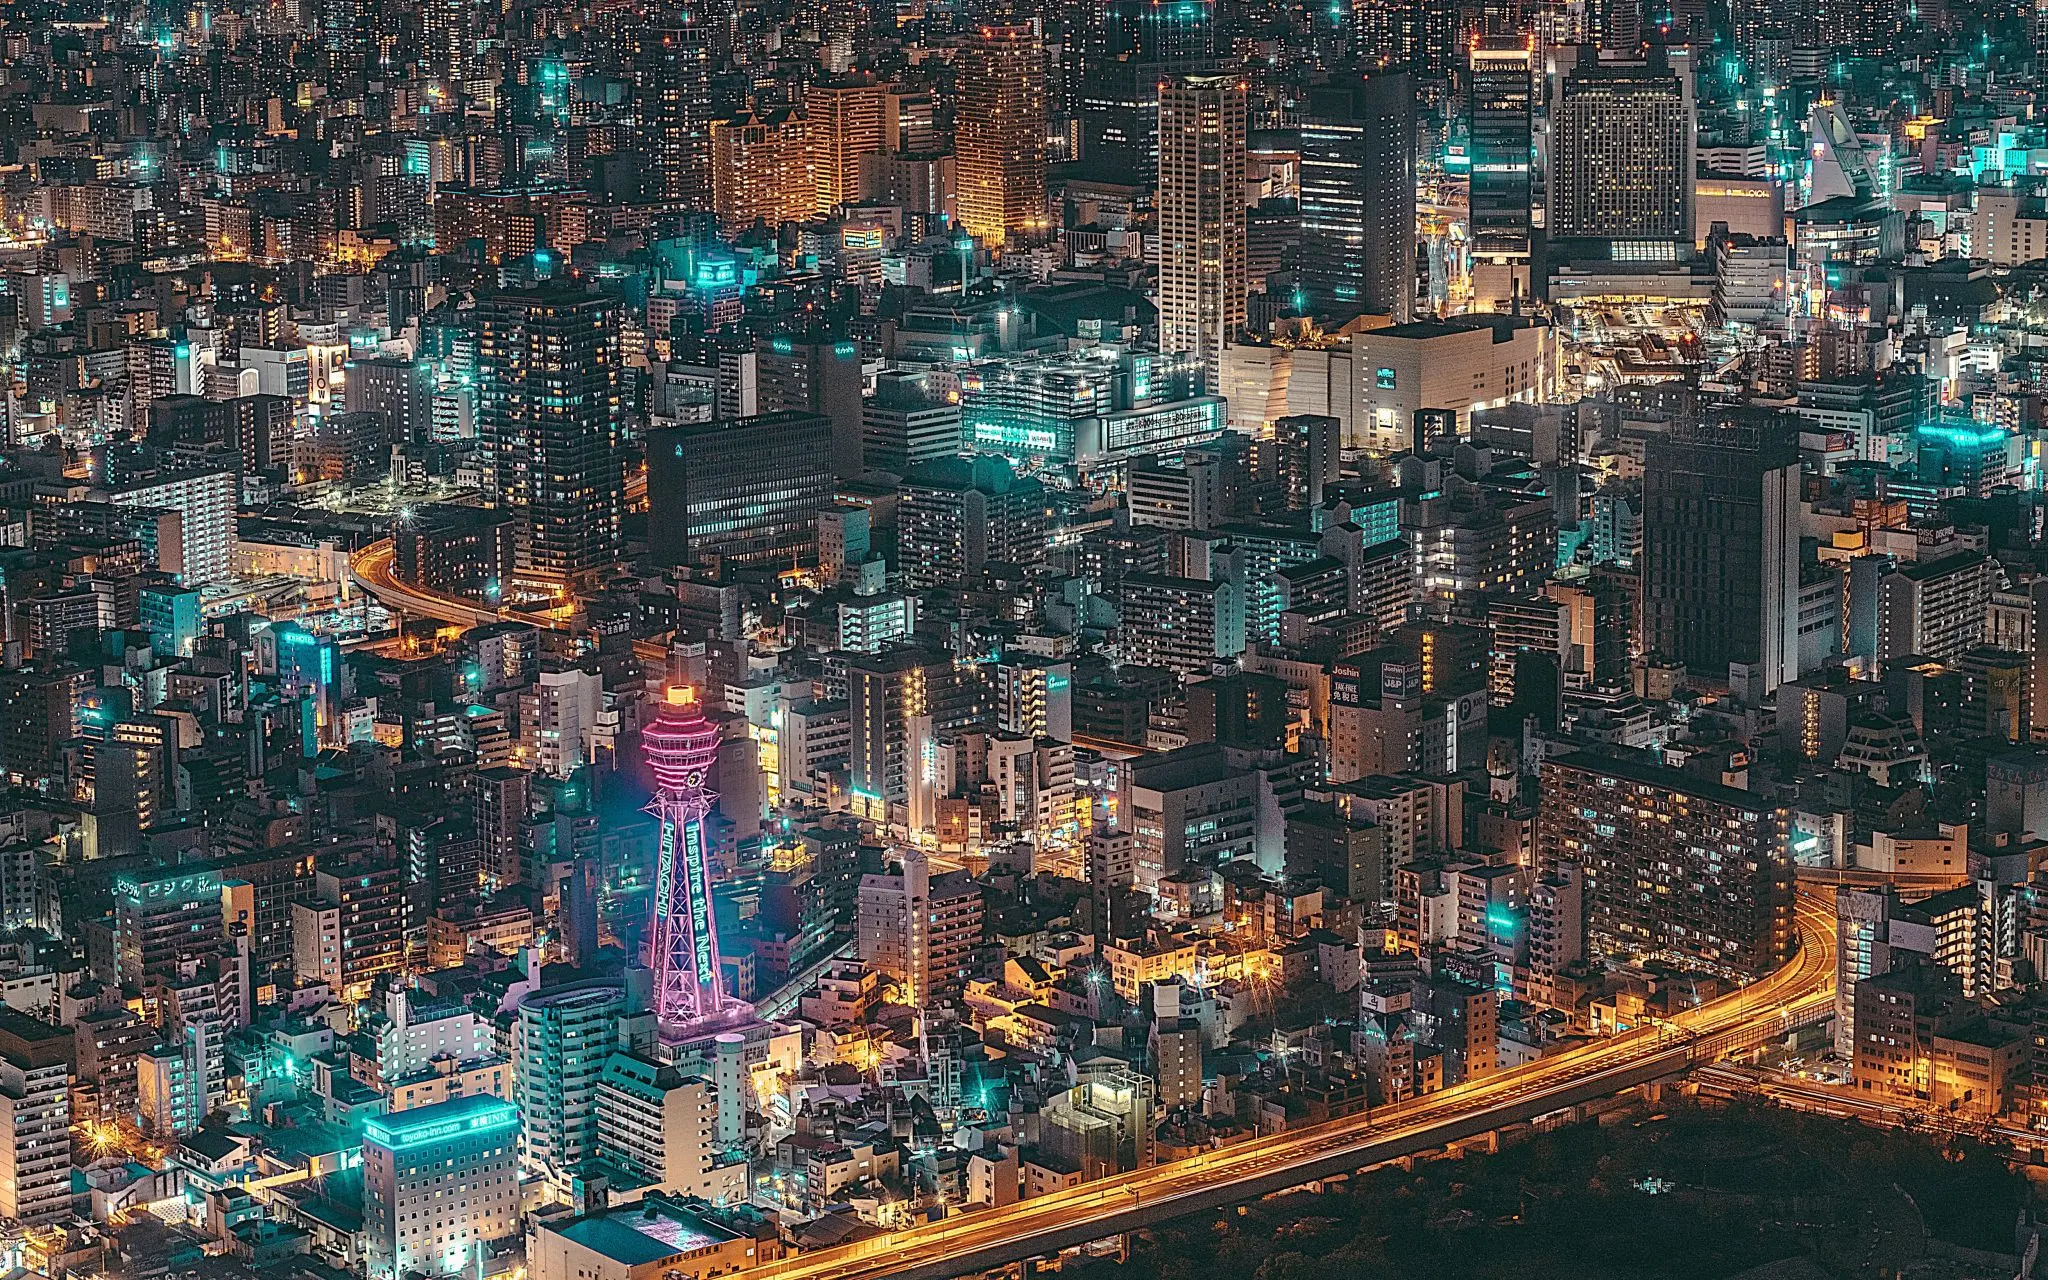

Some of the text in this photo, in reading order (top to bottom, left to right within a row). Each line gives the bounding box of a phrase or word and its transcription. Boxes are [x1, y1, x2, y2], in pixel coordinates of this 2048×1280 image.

[316, 348, 327, 400] ARROW
[1918, 528, 1934, 537] DISC
[1918, 536, 1934, 545] PIER
[1332, 665, 1360, 678] Joshin
[1384, 664, 1403, 675] Joshin
[1333, 682, 1358, 693] TAX-FREE
[1384, 679, 1402, 689] J&P
[1333, 690, 1358, 703] 免税店
[658, 822, 675, 917] HITACHI
[685, 823, 711, 984] Inspire the Next
[402, 1123, 460, 1143] toyoko-inn.com
